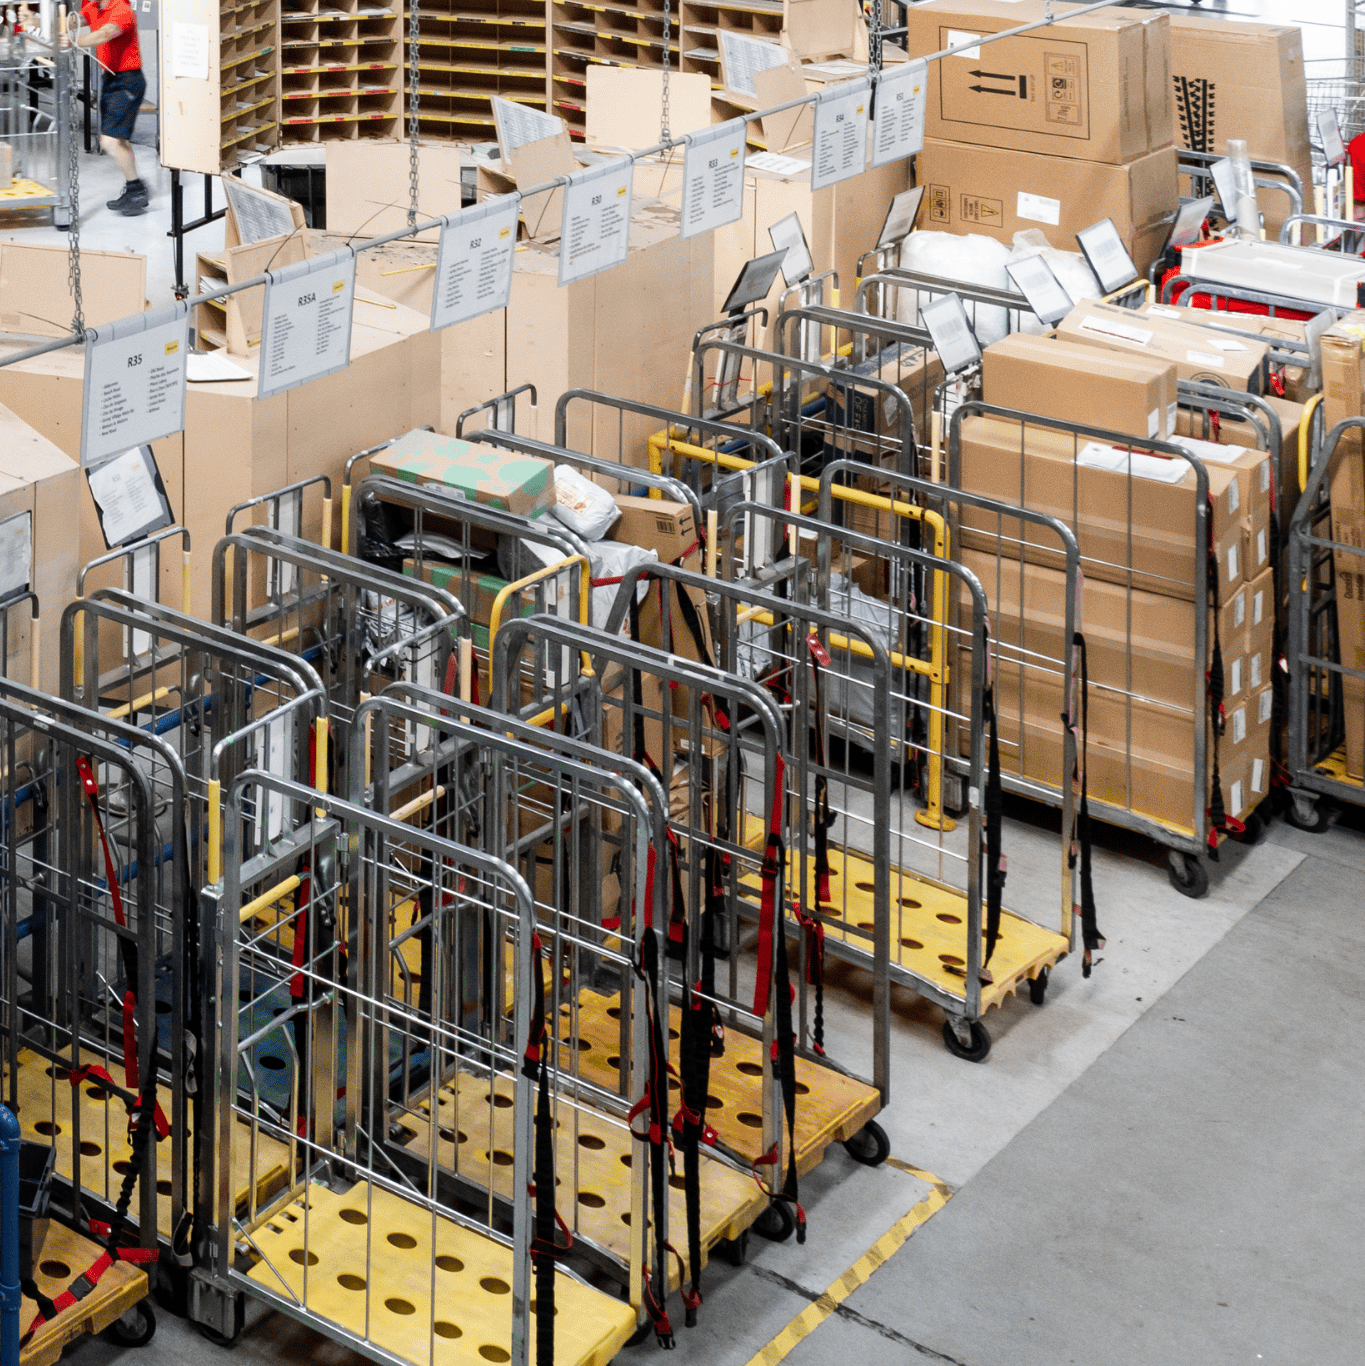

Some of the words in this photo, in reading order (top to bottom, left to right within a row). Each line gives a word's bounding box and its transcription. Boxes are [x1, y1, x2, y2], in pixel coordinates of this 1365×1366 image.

[470, 238, 482, 250] R32
[298, 293, 316, 307] R35A
[128, 354, 142, 368] R35
